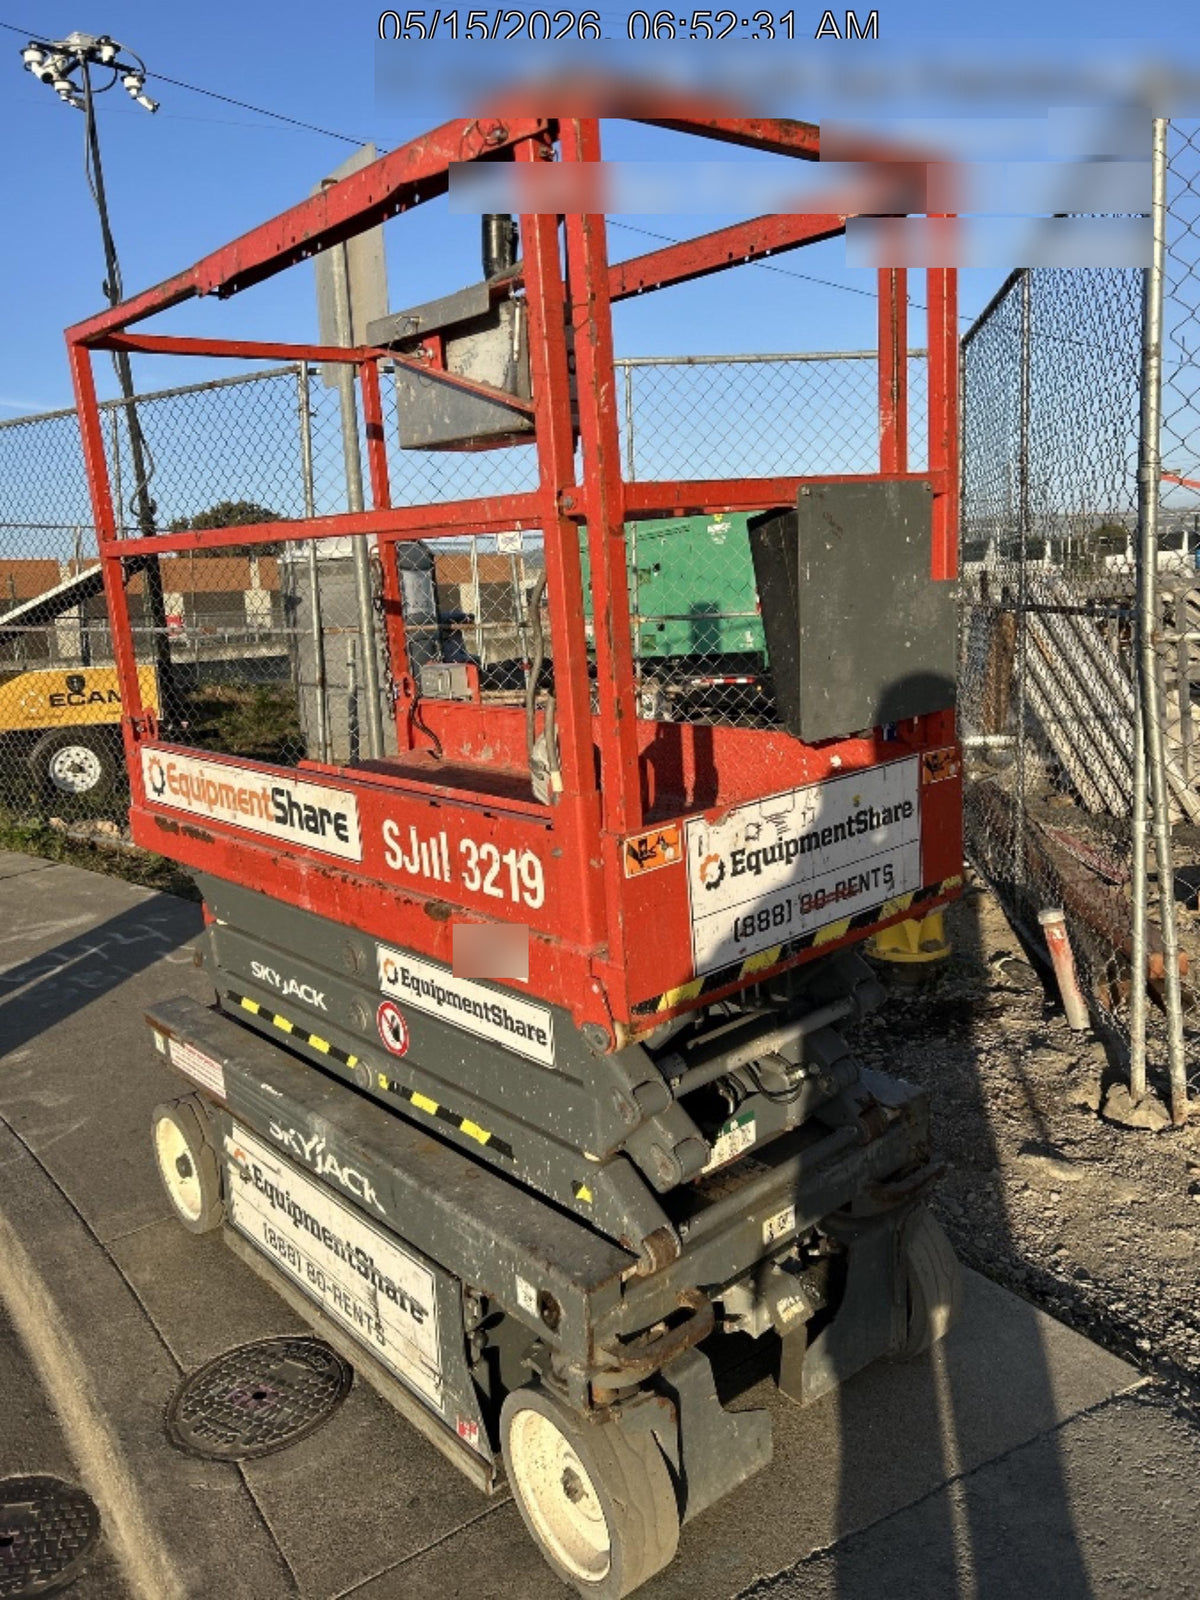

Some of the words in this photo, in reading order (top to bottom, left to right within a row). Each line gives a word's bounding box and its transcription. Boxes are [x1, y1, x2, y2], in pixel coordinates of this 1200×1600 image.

[166, 762, 349, 843] EquipmentShare
[730, 799, 913, 878] EquipmentShare
[459, 837, 545, 910] 3219
[733, 899, 792, 943] (888)
[250, 961, 328, 1011] SKYJACK
[400, 966, 548, 1046] EquipmentShare
[252, 1163, 430, 1326] EquipmentShare
[306, 1259, 387, 1347] 80-RENTS
